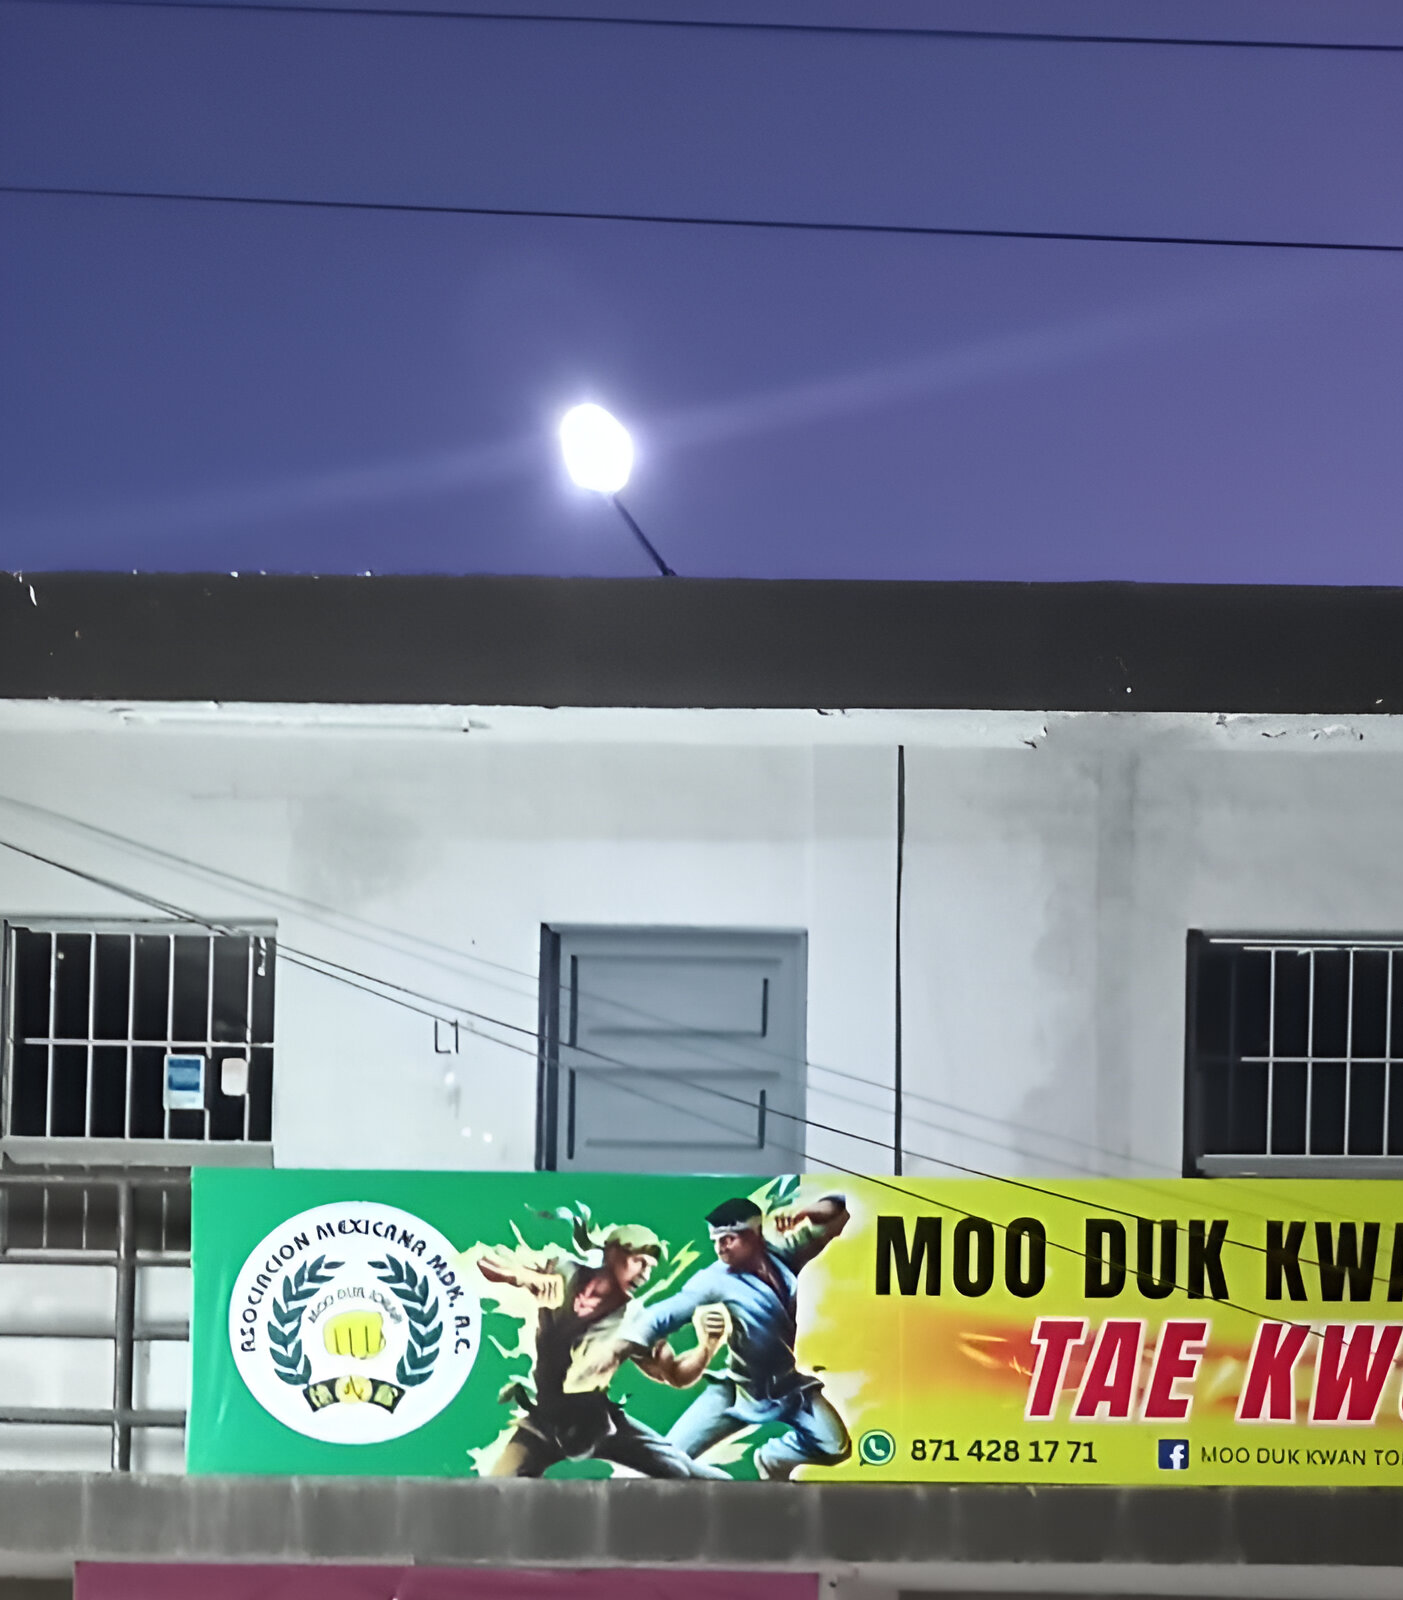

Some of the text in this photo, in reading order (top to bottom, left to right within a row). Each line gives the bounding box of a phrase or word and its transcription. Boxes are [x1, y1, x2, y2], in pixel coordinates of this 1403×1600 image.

[316, 1218, 427, 1257] MEXICANA
[876, 1215, 1047, 1298] MOO
[1084, 1217, 1230, 1300] DUK
[1025, 1316, 1211, 1421] TAE
[911, 1439, 1098, 1463] 871 428 17 71
[1201, 1446, 1251, 1464] MOO
[1257, 1447, 1300, 1465] DUK
[1306, 1448, 1366, 1466] KWAN
